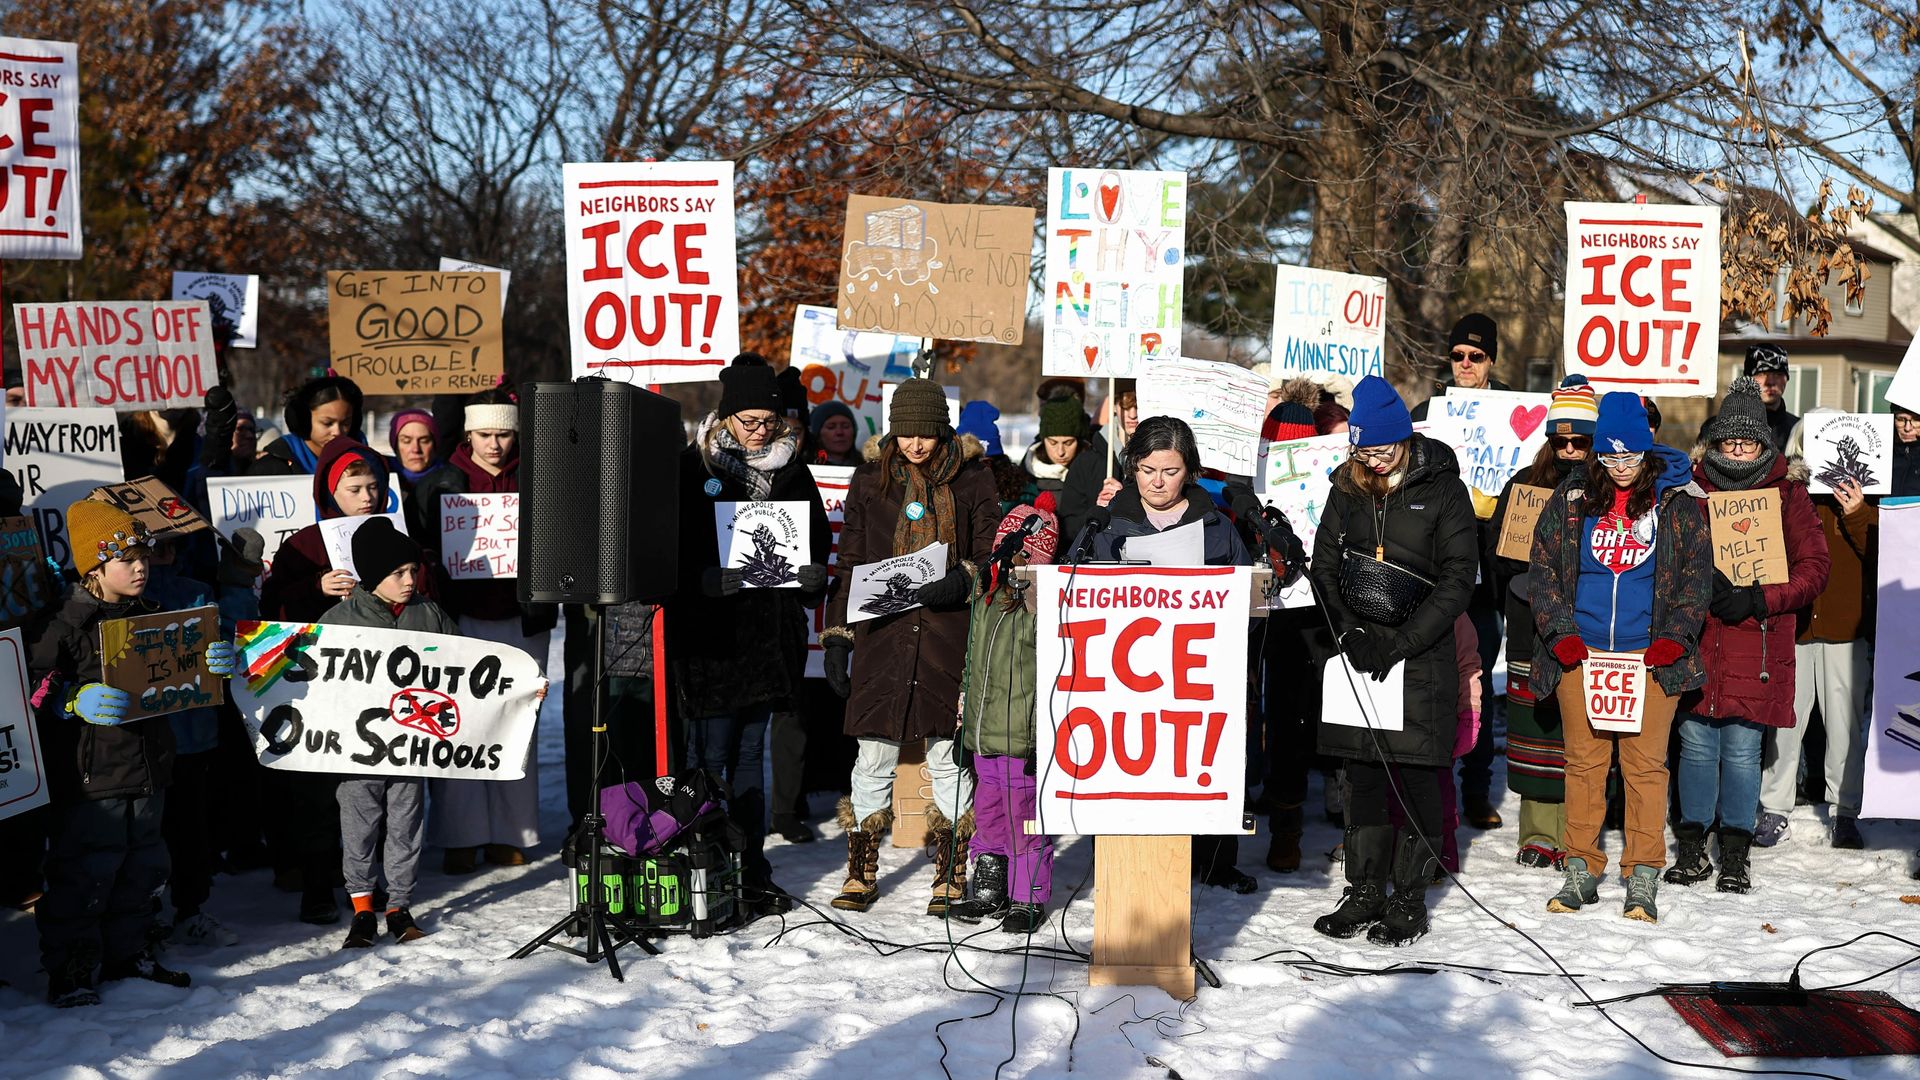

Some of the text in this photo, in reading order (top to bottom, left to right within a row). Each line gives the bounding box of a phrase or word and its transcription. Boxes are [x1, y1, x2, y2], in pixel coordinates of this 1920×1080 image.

[30, 73, 61, 88] SAY
[581, 196, 715, 216] NEIGHBORS SAY
[1060, 170, 1182, 227] LOVE
[940, 208, 1001, 250] WE
[1581, 233, 1700, 250] NEIGHBORS SAY
[582, 220, 710, 285] ICE
[1056, 228, 1171, 273] THY
[942, 252, 1032, 287] Are NOT
[1581, 254, 1692, 312] ICE
[400, 275, 486, 294] INTO
[1288, 280, 1384, 327] ICE OUT
[20, 307, 202, 350] HANDS OFF
[356, 303, 483, 340] GOOD
[584, 291, 722, 354] OUT!
[1321, 320, 1333, 336] of
[1284, 335, 1382, 376] MINNESOTA
[1577, 315, 1701, 374] OUT!
[337, 346, 481, 377] TROUBLE!
[27, 353, 207, 408] MY SCHOOL
[411, 374, 497, 389] RIP RENEE
[1447, 401, 1481, 420] WE
[58, 423, 116, 453] FROM
[1820, 416, 1859, 433] MINNEAPOLIS
[222, 487, 295, 523] DONALD
[444, 496, 491, 509] WOULD
[443, 516, 465, 532] BE
[472, 514, 494, 530] IN
[732, 501, 798, 539] MINNEAPOLIS FAMILIES
[755, 509, 776, 518] PUBLIC
[777, 516, 791, 543] SCHOOLS
[1510, 513, 1528, 523] are
[474, 537, 517, 551] BUT
[1506, 531, 1530, 545] need
[1720, 537, 1768, 560] MELT
[448, 551, 486, 576] HERE
[869, 556, 936, 577] MINNEAPOLIS FAMILIES
[916, 564, 928, 581] SCHOOLS
[1732, 559, 1767, 582] ICE
[1058, 585, 1229, 609] NEIGHBORS SAY
[134, 617, 203, 654] ICE
[177, 651, 202, 672] NOT
[284, 633, 514, 699] STAY OUT OF
[1056, 616, 1216, 700] ICE
[1590, 662, 1626, 670] NEIGHBORS
[1590, 670, 1635, 694] ICE
[1591, 693, 1637, 718] OUT!
[260, 704, 503, 770] OUR SCHOOLS
[1054, 706, 1228, 787] OUT!
